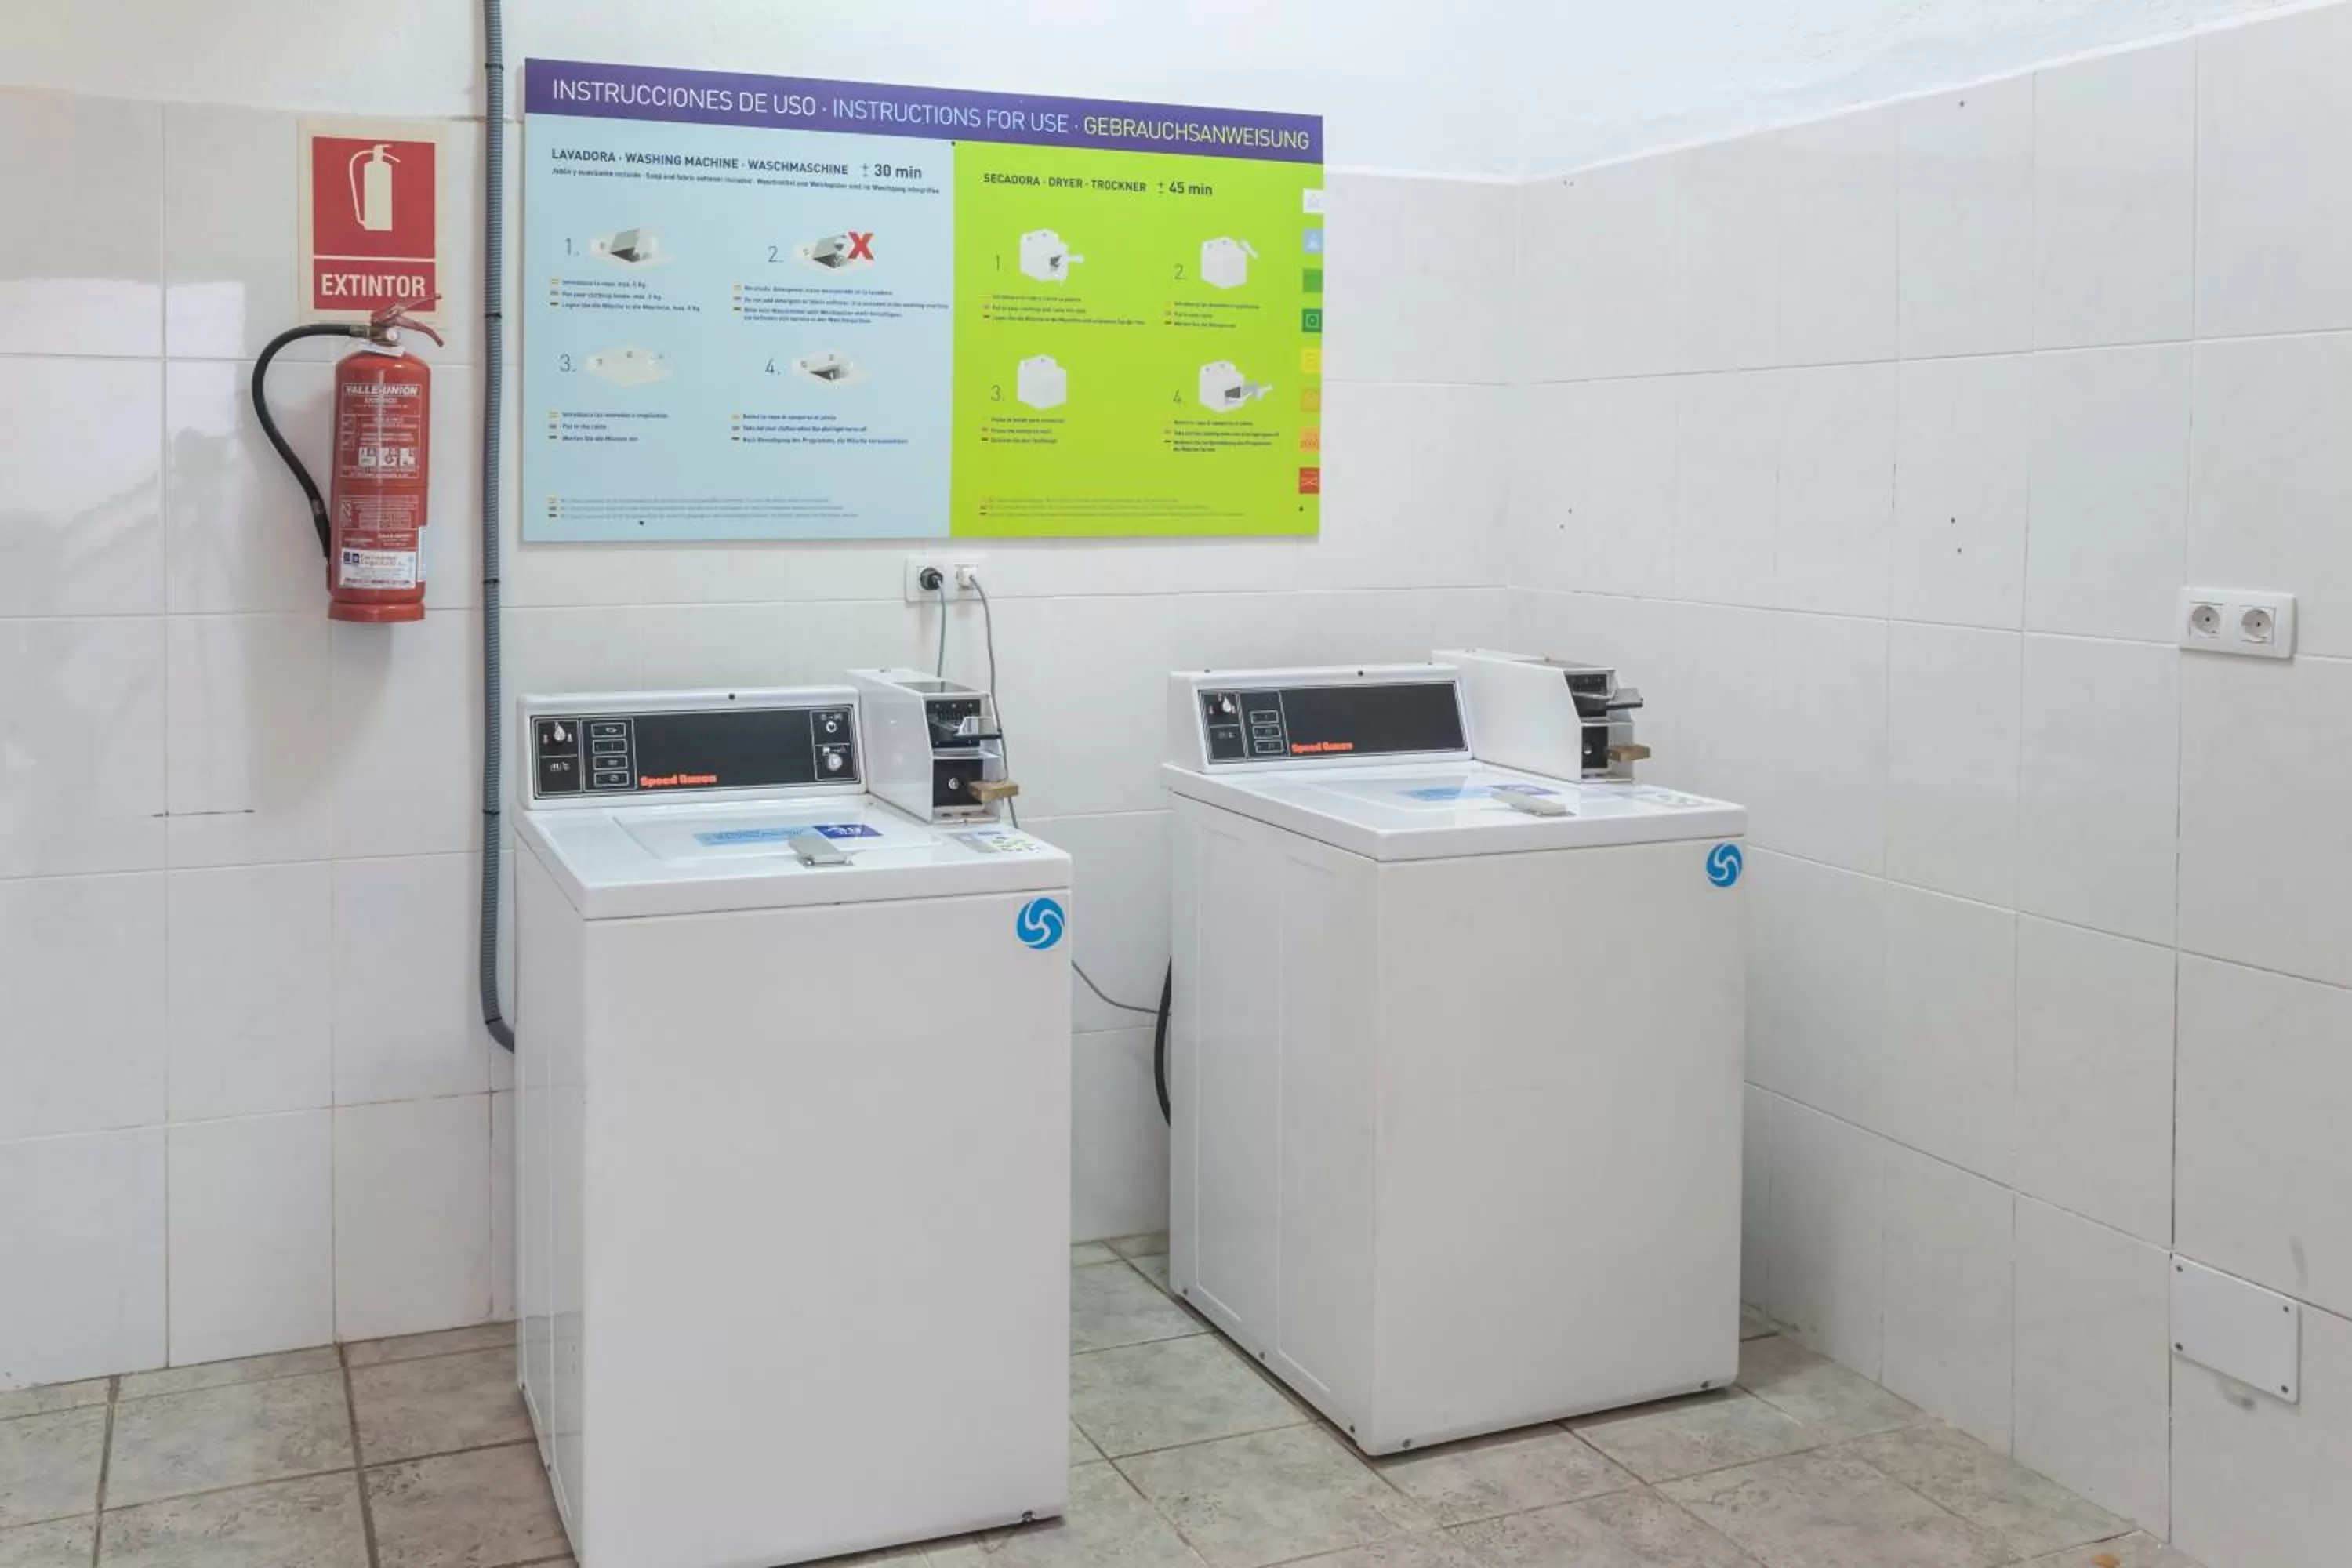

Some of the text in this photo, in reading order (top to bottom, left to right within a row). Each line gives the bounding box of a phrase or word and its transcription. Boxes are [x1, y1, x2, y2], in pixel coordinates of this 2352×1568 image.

[553, 78, 1309, 150] INSTRUCCIONES DE USO INSTRUCTIONS FOR USE GEBRAUCHSANWEISUNG
[551, 148, 615, 162] LAVADORA
[625, 152, 682, 166] WASHING
[684, 154, 738, 169] MACHINE
[747, 159, 848, 175] WASCHMASCHINE
[874, 163, 891, 177] 30
[895, 165, 922, 179] min
[983, 173, 1040, 187] SECADORA
[1048, 176, 1083, 189] DRYER
[1091, 180, 1147, 192] TROCKNER
[1168, 181, 1185, 194] 45
[1188, 183, 1213, 196] min
[320, 273, 426, 298] EXTINTOR
